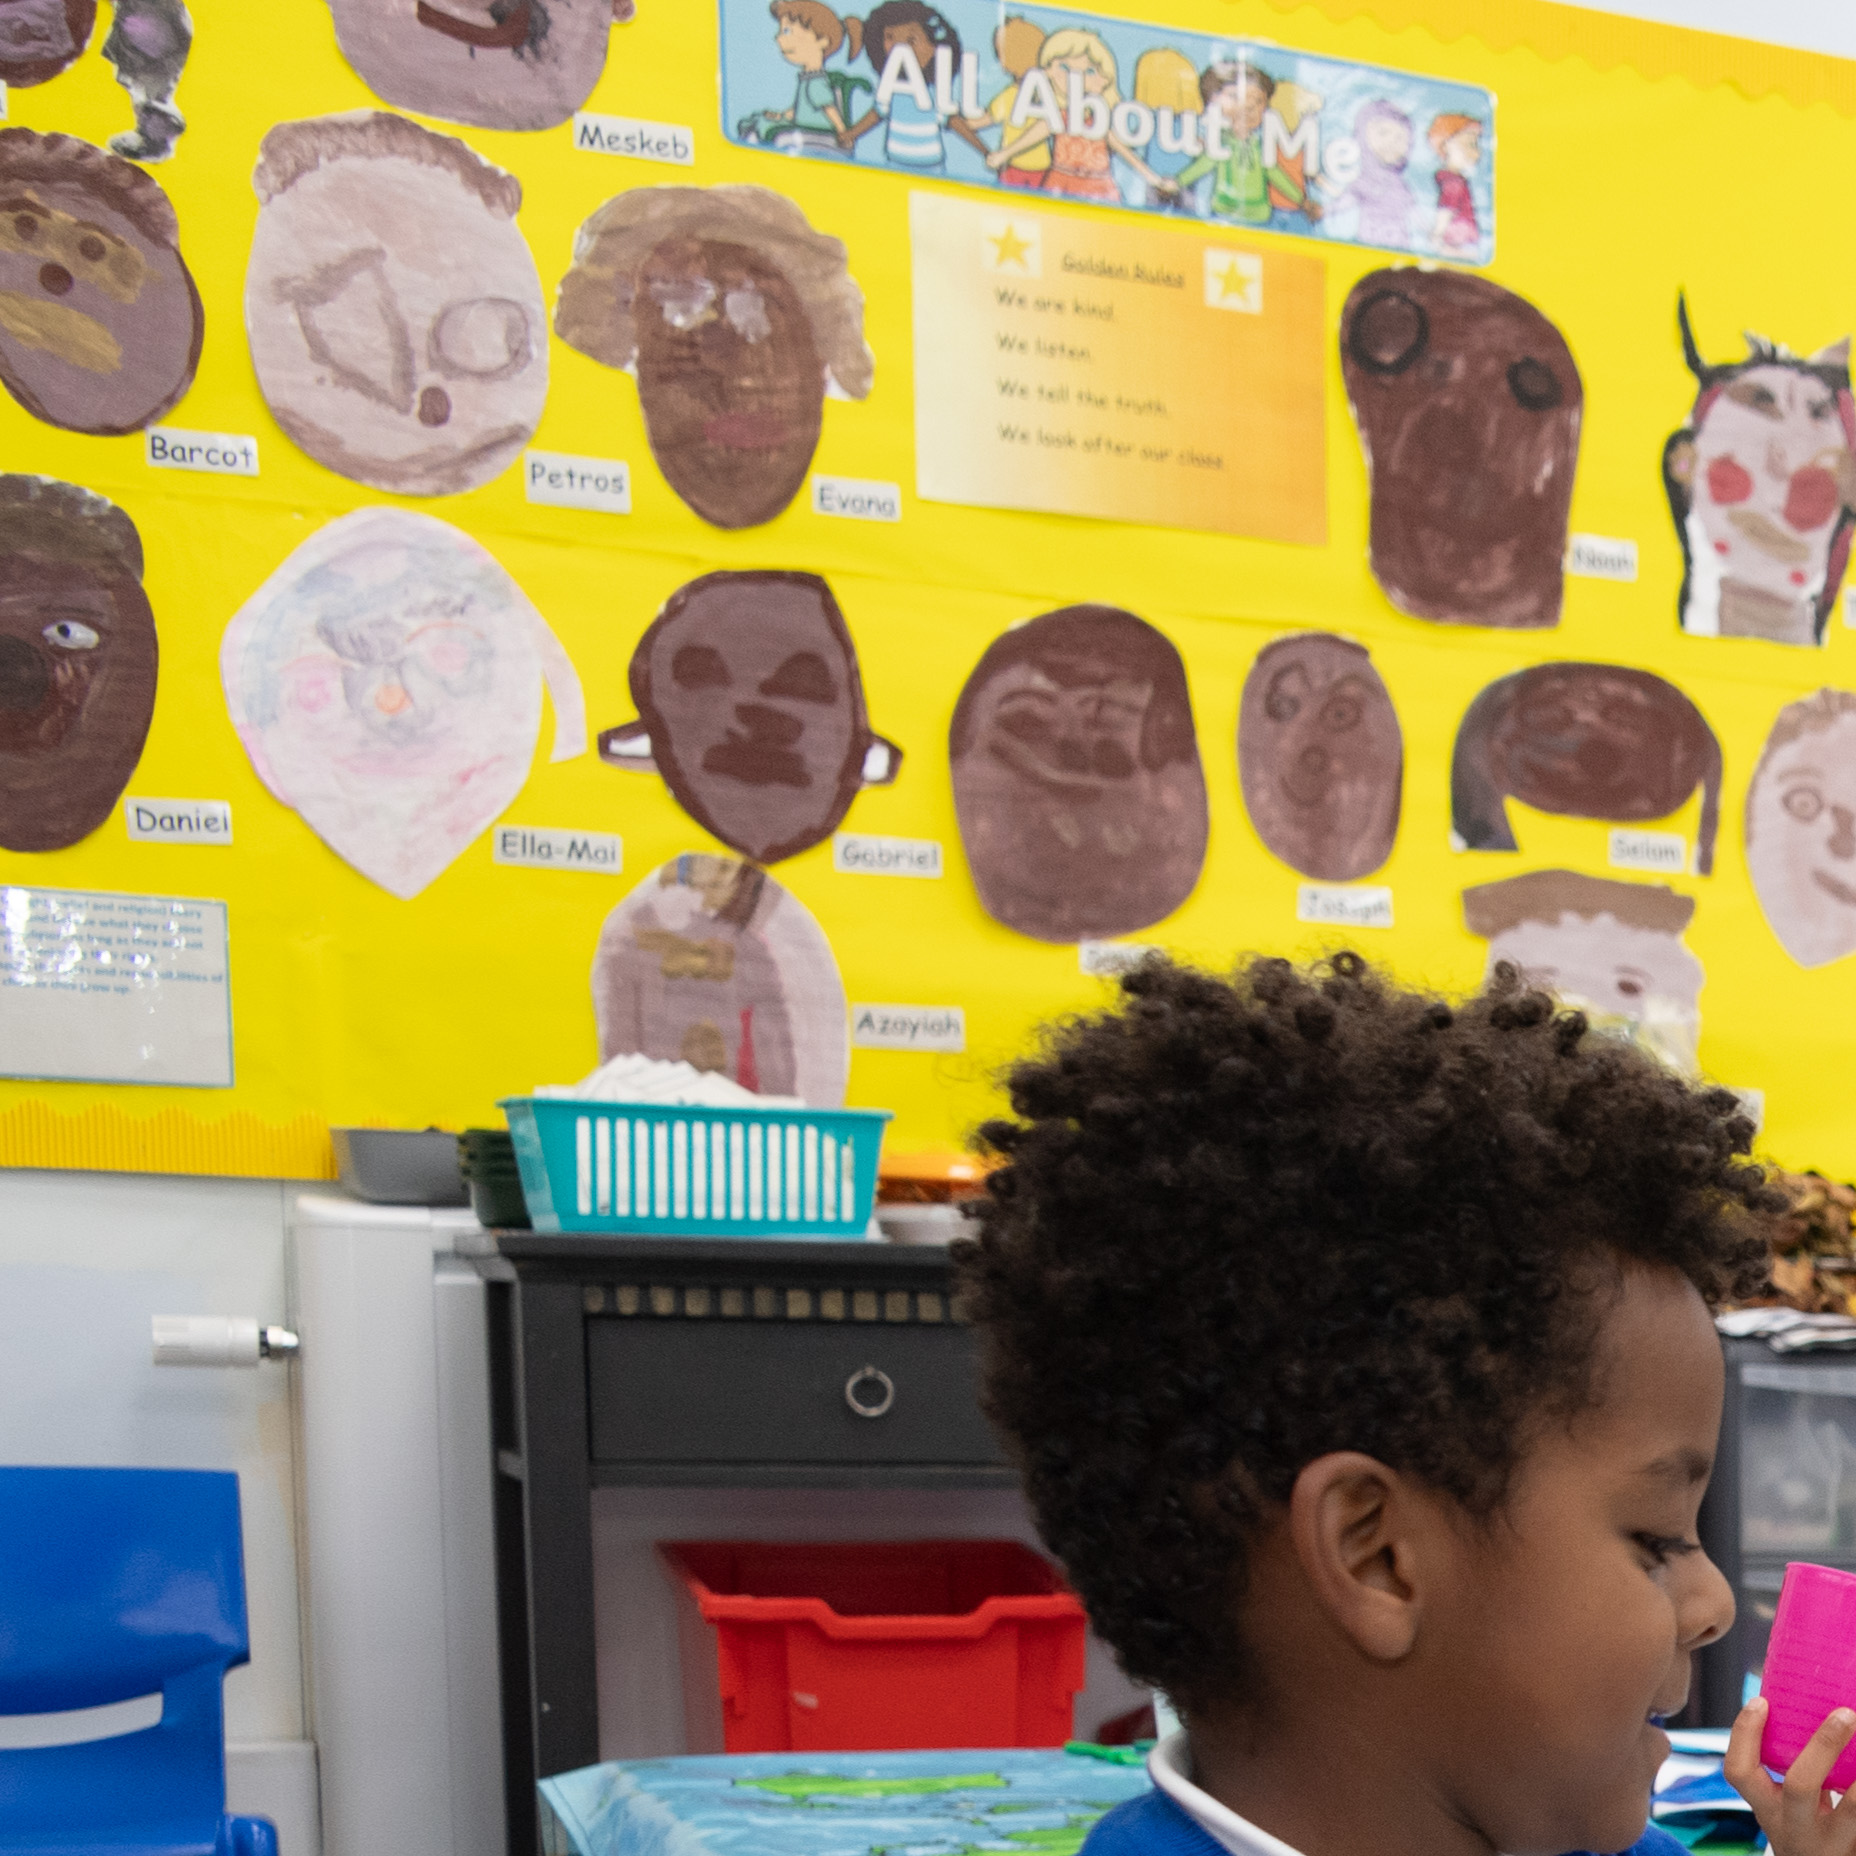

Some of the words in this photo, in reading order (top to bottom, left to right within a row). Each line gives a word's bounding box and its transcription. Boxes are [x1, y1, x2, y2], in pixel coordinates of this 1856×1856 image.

[876, 44, 984, 119] All
[1011, 70, 1236, 161] About
[1262, 115, 1362, 184] Me
[578, 122, 689, 160] Meskeb
[150, 434, 254, 470] Barcot
[530, 461, 624, 496] Petros
[136, 807, 229, 834] Daniel
[501, 832, 618, 866] Ella-Mai
[842, 840, 941, 869] Gabriel
